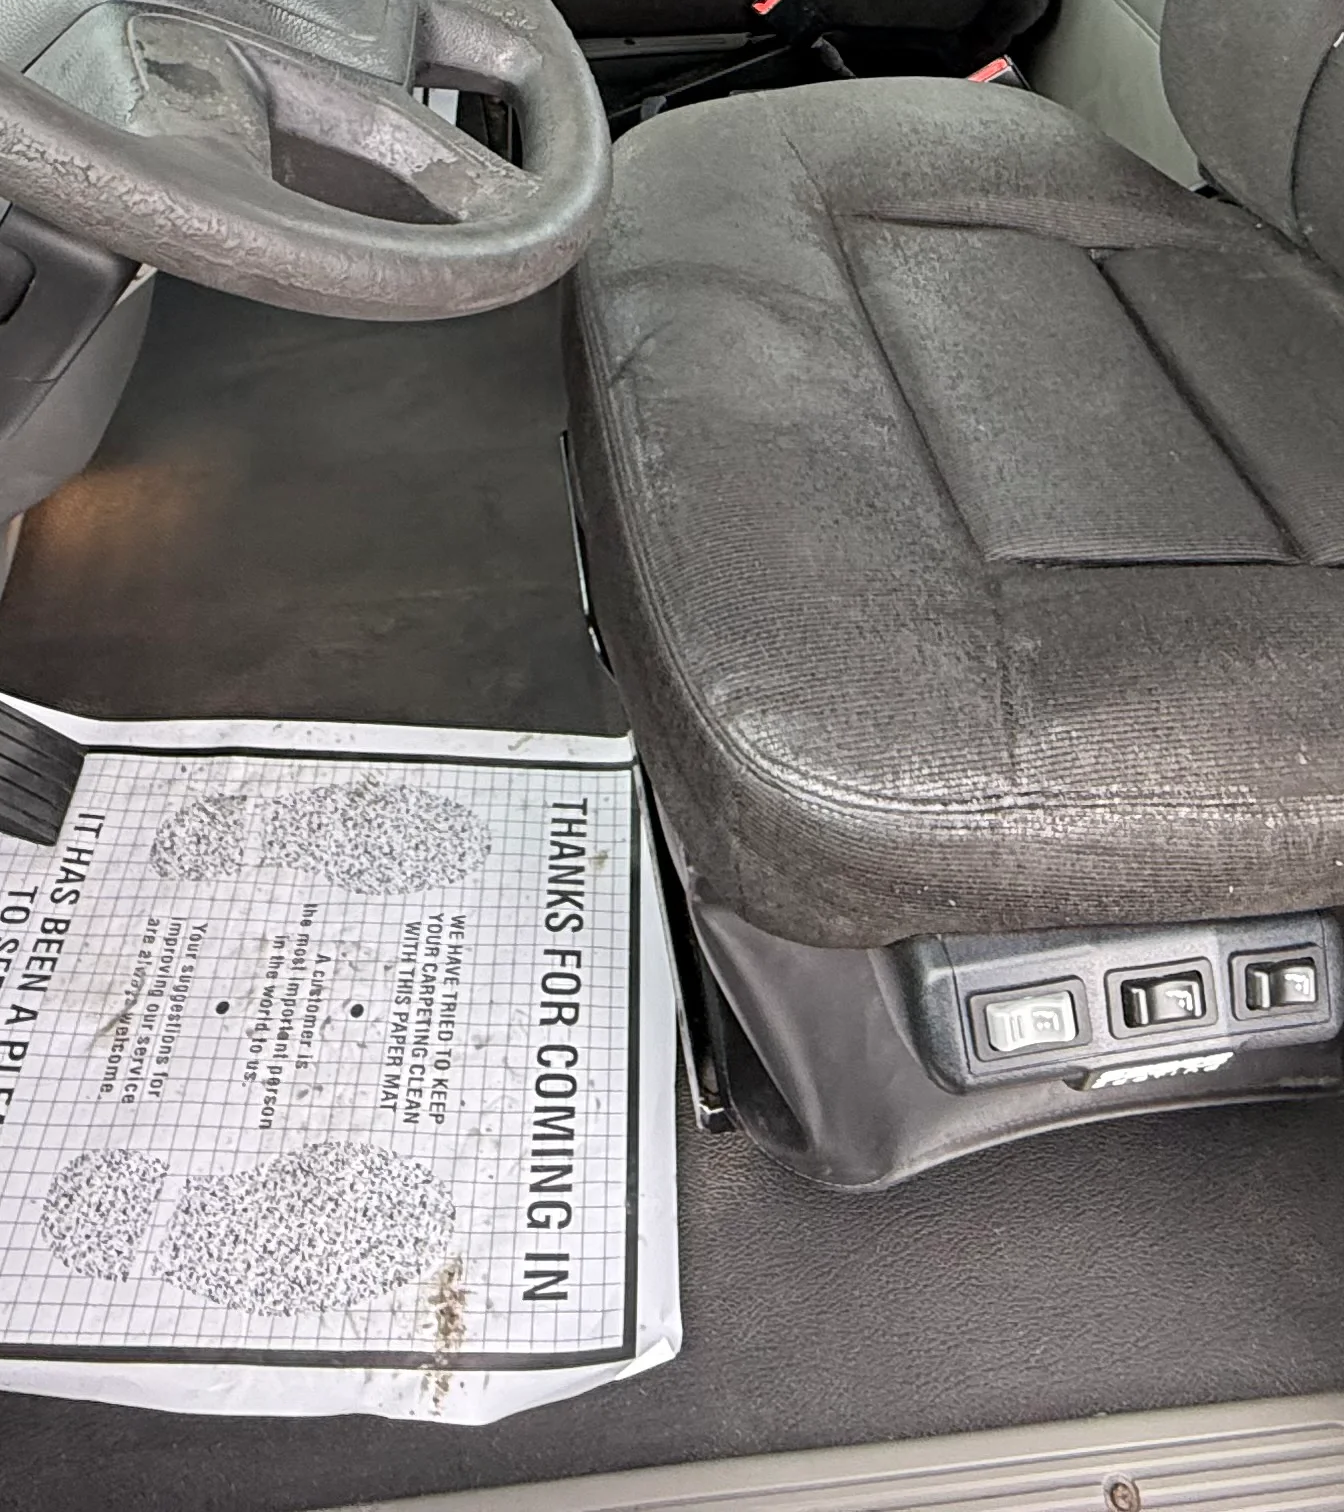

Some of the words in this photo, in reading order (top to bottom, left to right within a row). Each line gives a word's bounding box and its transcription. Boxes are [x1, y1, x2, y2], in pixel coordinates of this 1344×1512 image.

[77, 812, 106, 839] IT
[49, 845, 94, 907] HAS
[544, 798, 588, 934] THANKS
[142, 918, 161, 945] are
[300, 903, 318, 927] the
[423, 912, 444, 958] YOUR
[449, 915, 467, 940] WE
[16, 916, 71, 993] BEEN
[147, 917, 188, 998] improving
[185, 922, 208, 960] Your
[273, 935, 290, 949] in
[291, 933, 309, 971] most
[315, 953, 332, 964] A
[401, 921, 422, 964] WITH
[266, 955, 285, 980] the
[394, 968, 416, 1006] THIS
[443, 945, 464, 986] HAVE
[254, 985, 275, 1032] world
[300, 970, 325, 1048] customer
[539, 948, 583, 1027] FOR
[4, 1003, 38, 1026] A
[141, 1003, 160, 1031] our
[156, 964, 195, 1065] suggestions
[411, 963, 438, 1059] CARPETING
[437, 992, 459, 1042] TRIED
[249, 1038, 267, 1054] to
[387, 1011, 409, 1067] PAPER
[433, 1048, 452, 1071] TO
[121, 1036, 151, 1104] service
[295, 1054, 313, 1069] is
[148, 1072, 169, 1098] for
[258, 1065, 283, 1130] person
[380, 1074, 401, 1112] MAT
[402, 1063, 426, 1124] CLEAN
[428, 1077, 449, 1125] KEEP
[526, 1044, 579, 1230] COMING
[522, 1251, 571, 1302] IN
